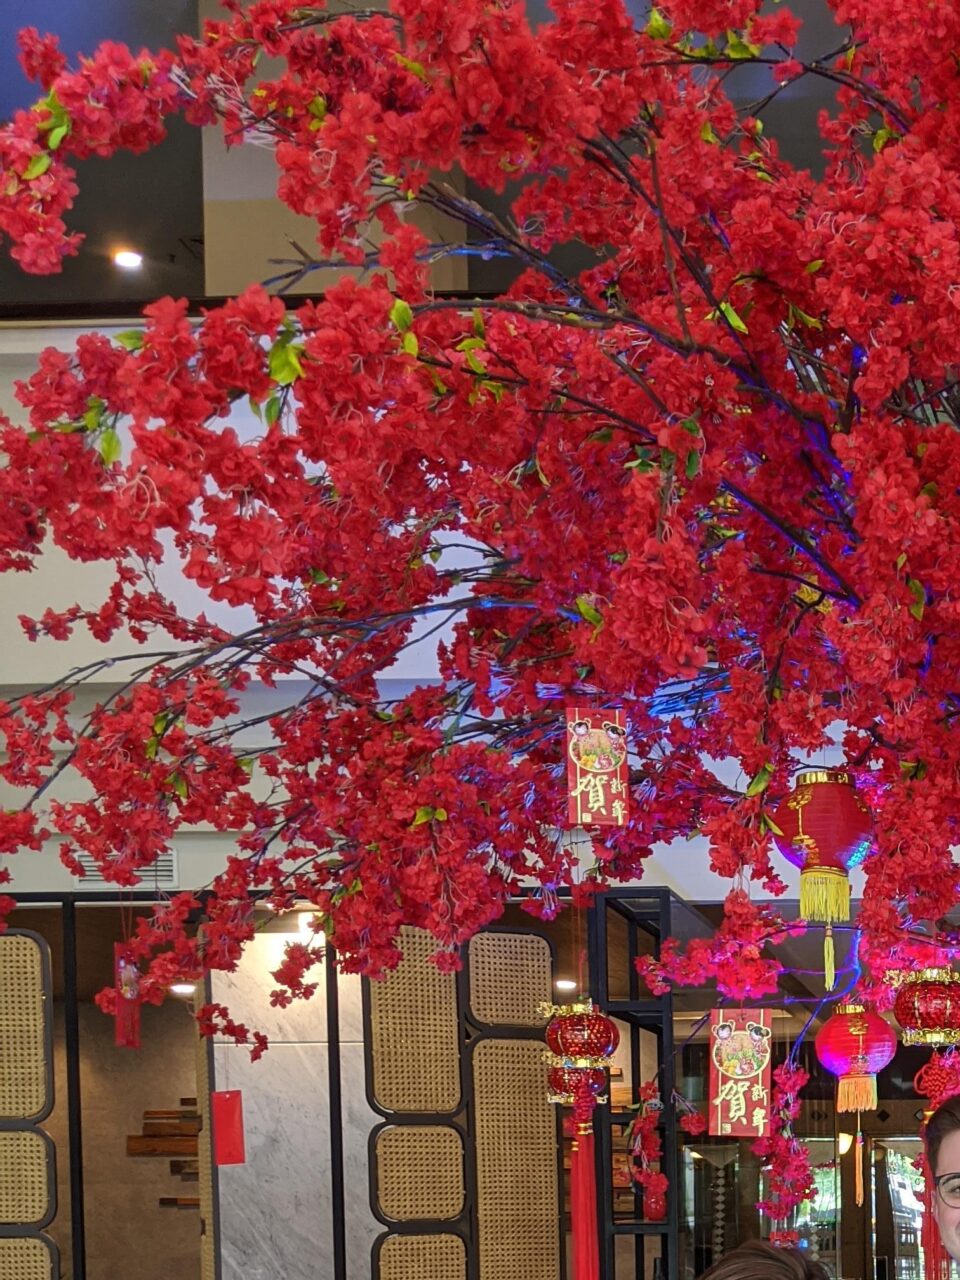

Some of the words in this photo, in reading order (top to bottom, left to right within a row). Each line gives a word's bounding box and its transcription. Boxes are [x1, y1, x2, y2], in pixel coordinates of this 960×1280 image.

[571, 773, 608, 815] 賀
[712, 1080, 751, 1125] 賀
[751, 1083, 769, 1137] 新年
